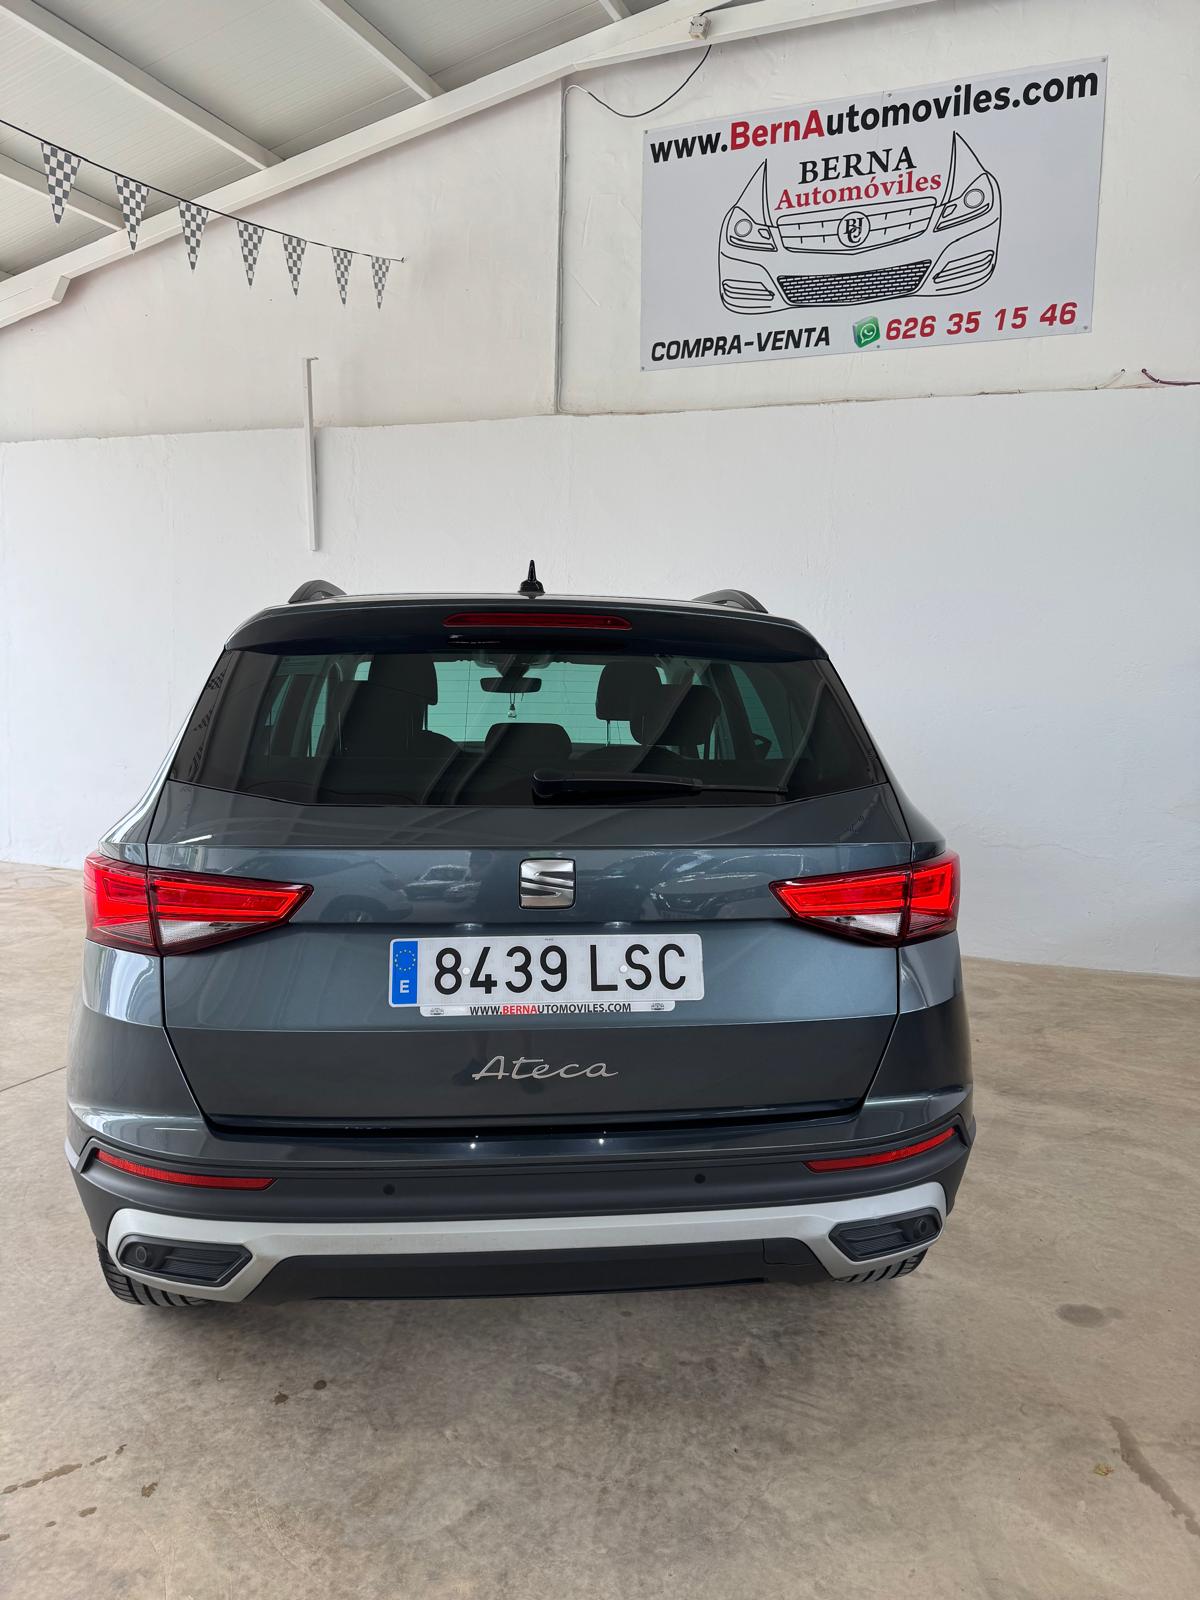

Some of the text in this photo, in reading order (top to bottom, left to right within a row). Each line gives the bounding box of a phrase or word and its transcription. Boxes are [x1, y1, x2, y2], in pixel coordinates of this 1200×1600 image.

[650, 72, 1098, 163] www.BernAutomoviles.com
[798, 146, 917, 185] BERNA
[774, 171, 942, 211] Automóviles
[885, 301, 1078, 340] 626 35 15 46
[651, 326, 831, 362] COMPRA-VENTA
[400, 980, 409, 993] E
[434, 943, 686, 995] 8439 LSC
[470, 1002, 631, 1016] WWW.BERNAUTOMOVILES.COM
[471, 1055, 618, 1081] Ateca
